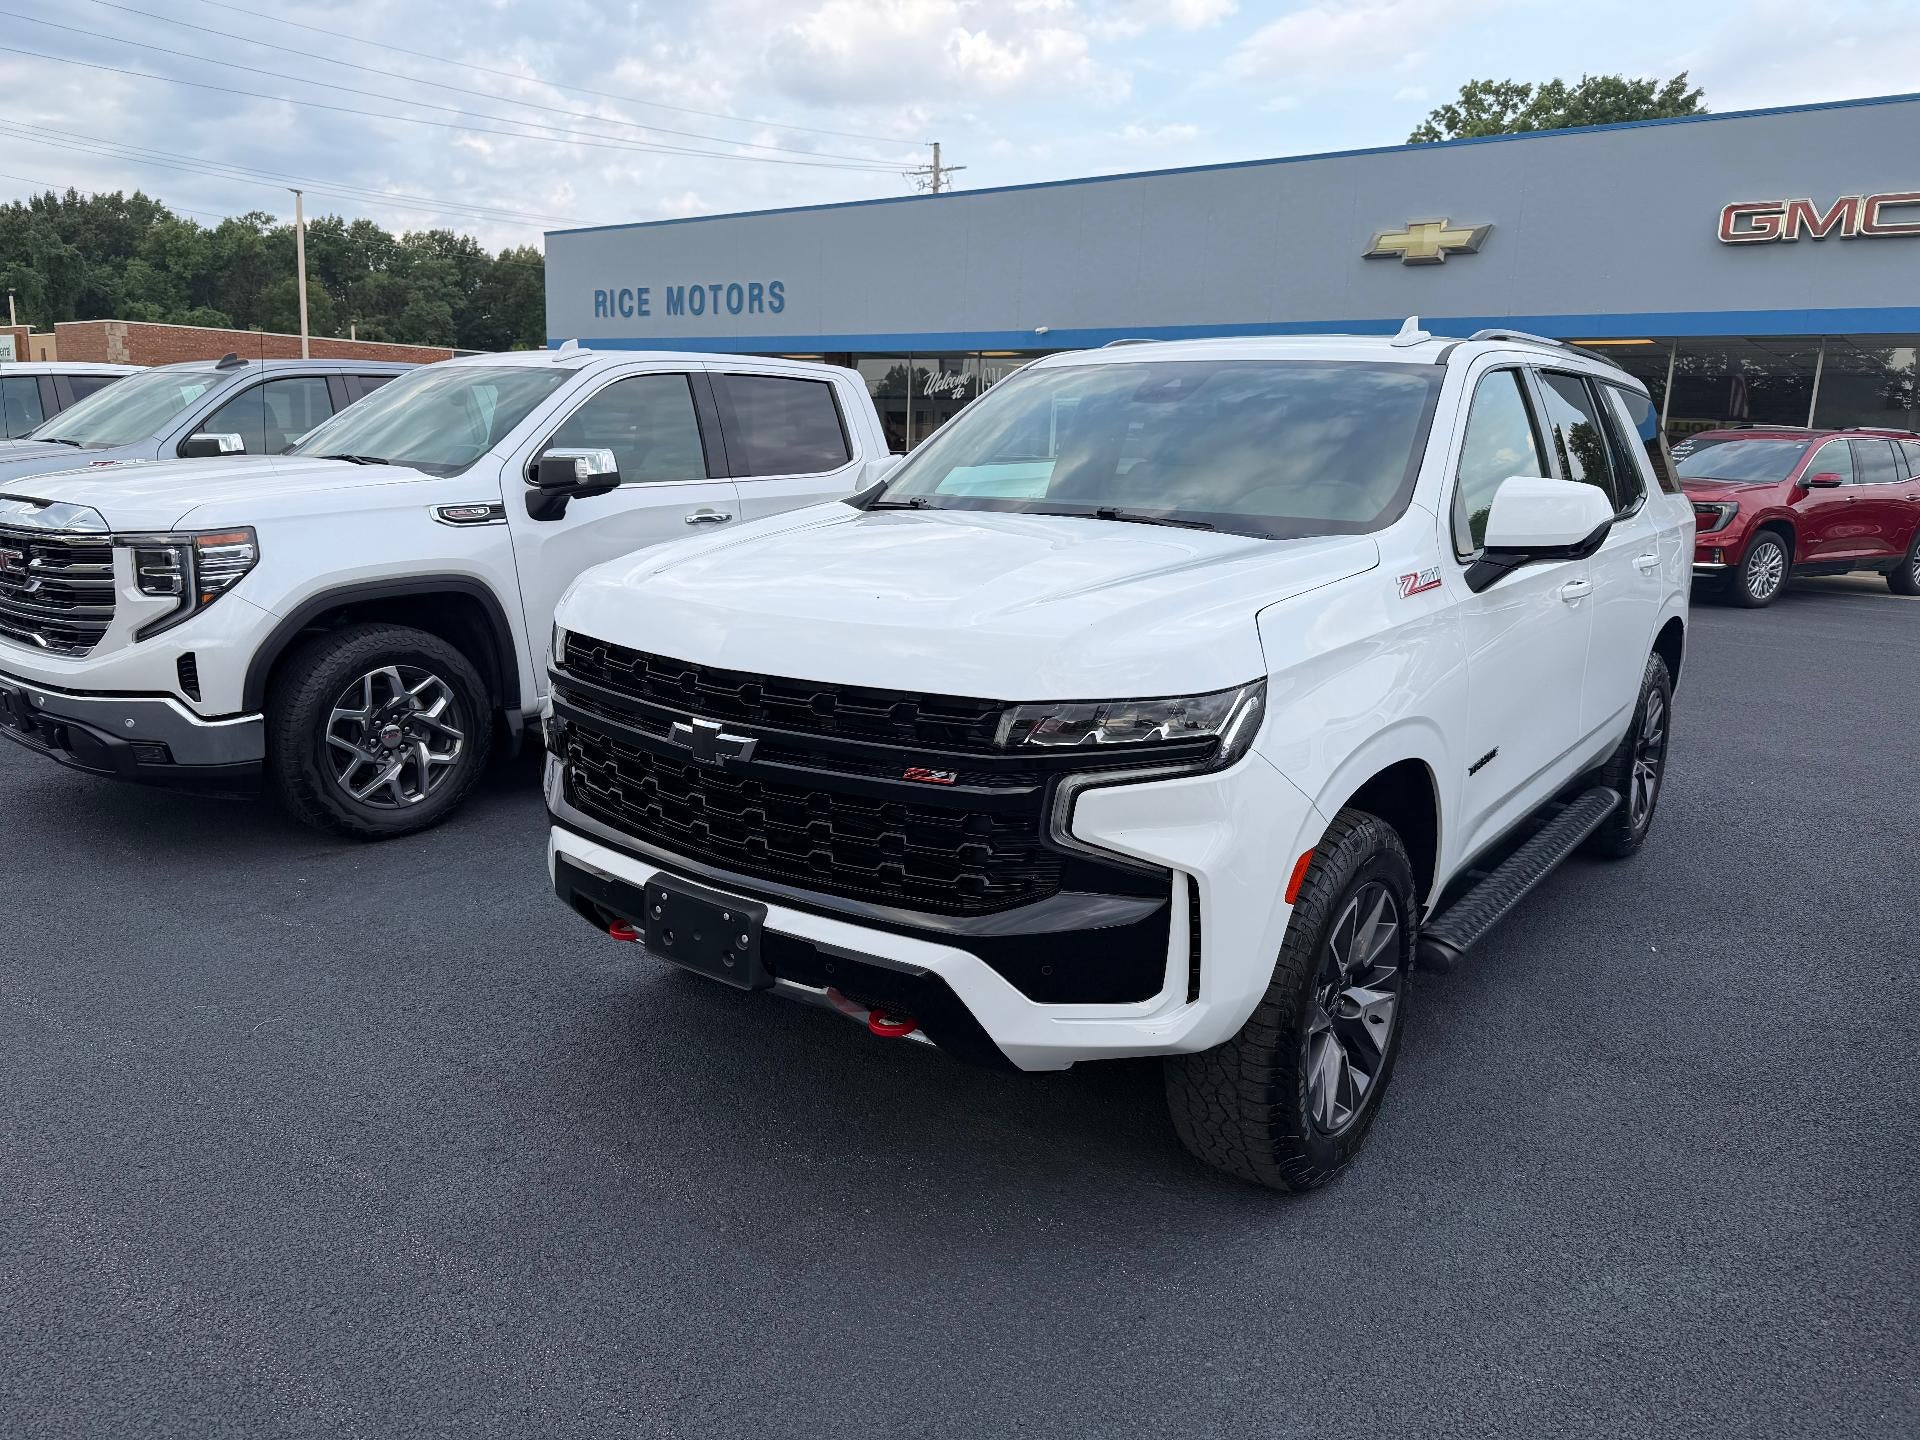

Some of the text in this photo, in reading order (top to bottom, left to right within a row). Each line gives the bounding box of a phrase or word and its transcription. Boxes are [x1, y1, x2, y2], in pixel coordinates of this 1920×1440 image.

[1718, 192, 1920, 244] GMC
[594, 281, 785, 318] RICE MOTORS
[923, 370, 970, 395] Welcome
[951, 385, 965, 399] to
